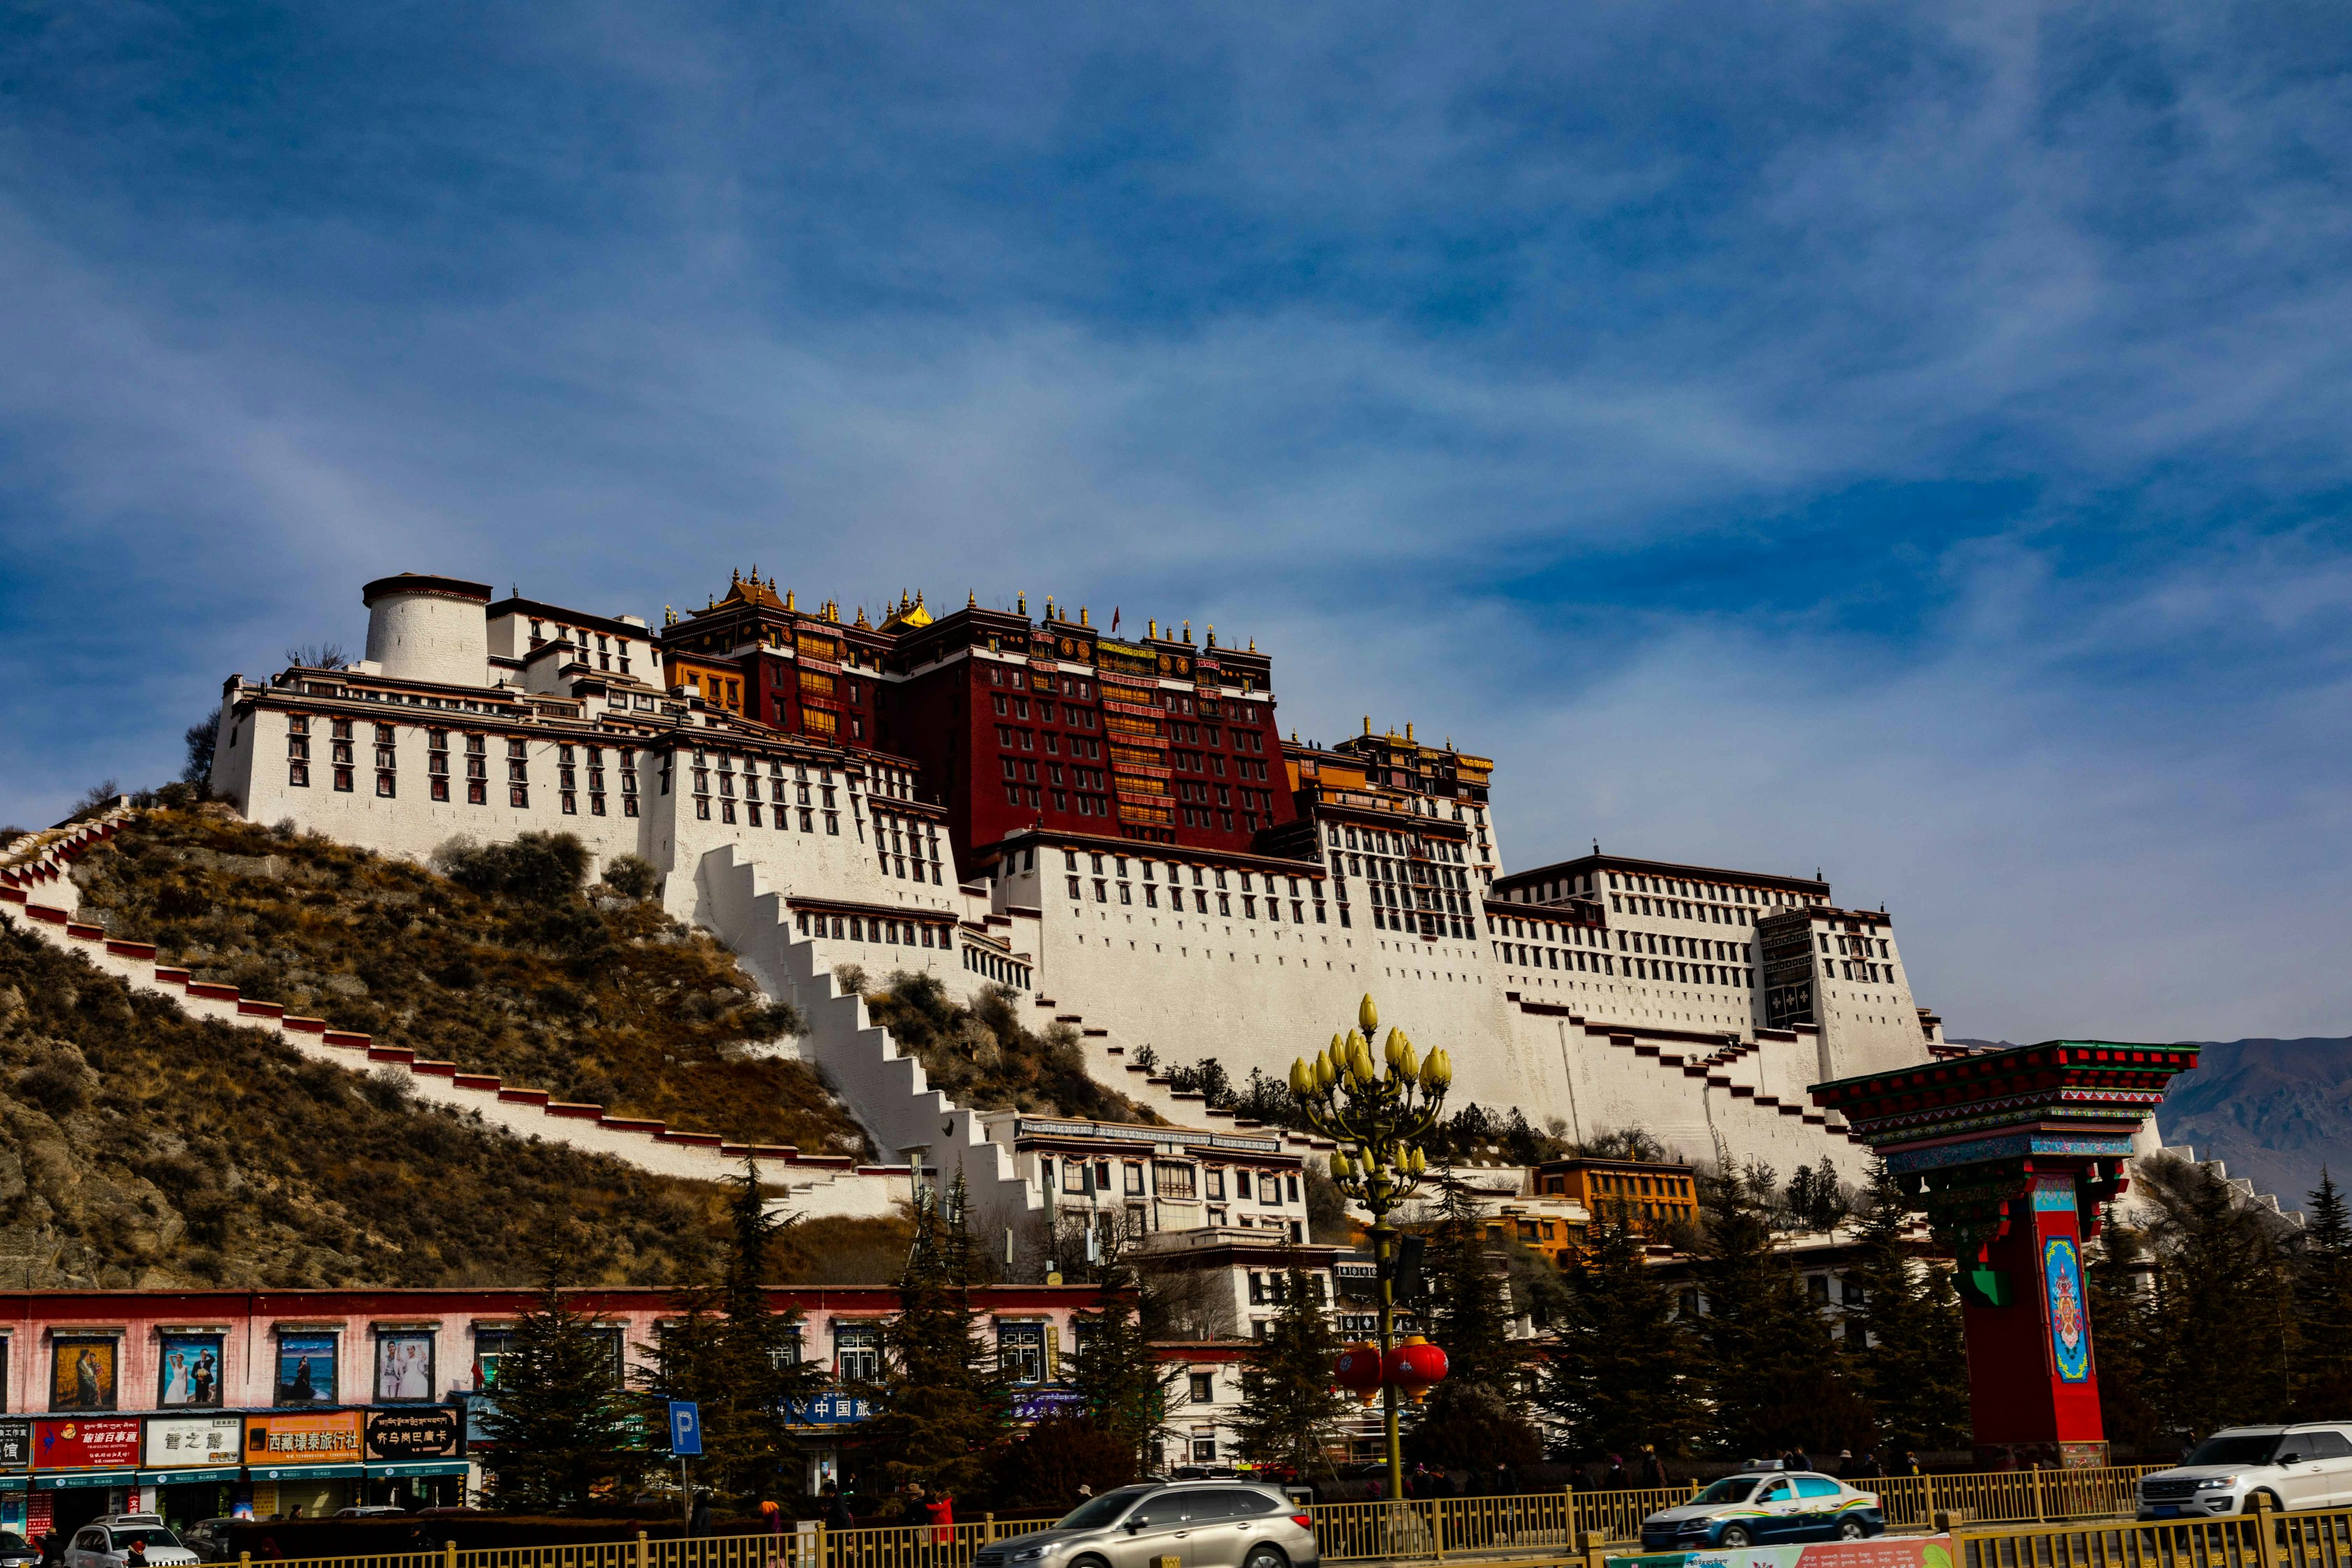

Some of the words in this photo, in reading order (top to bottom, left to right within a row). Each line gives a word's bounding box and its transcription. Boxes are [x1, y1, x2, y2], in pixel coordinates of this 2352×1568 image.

[815, 1400, 892, 1418] 中国旅
[81, 1431, 138, 1443] 旅游百事通
[676, 1411, 693, 1445] P
[165, 1432, 224, 1450] 雪之露
[268, 1430, 359, 1452] 西藏璟泰旅行社
